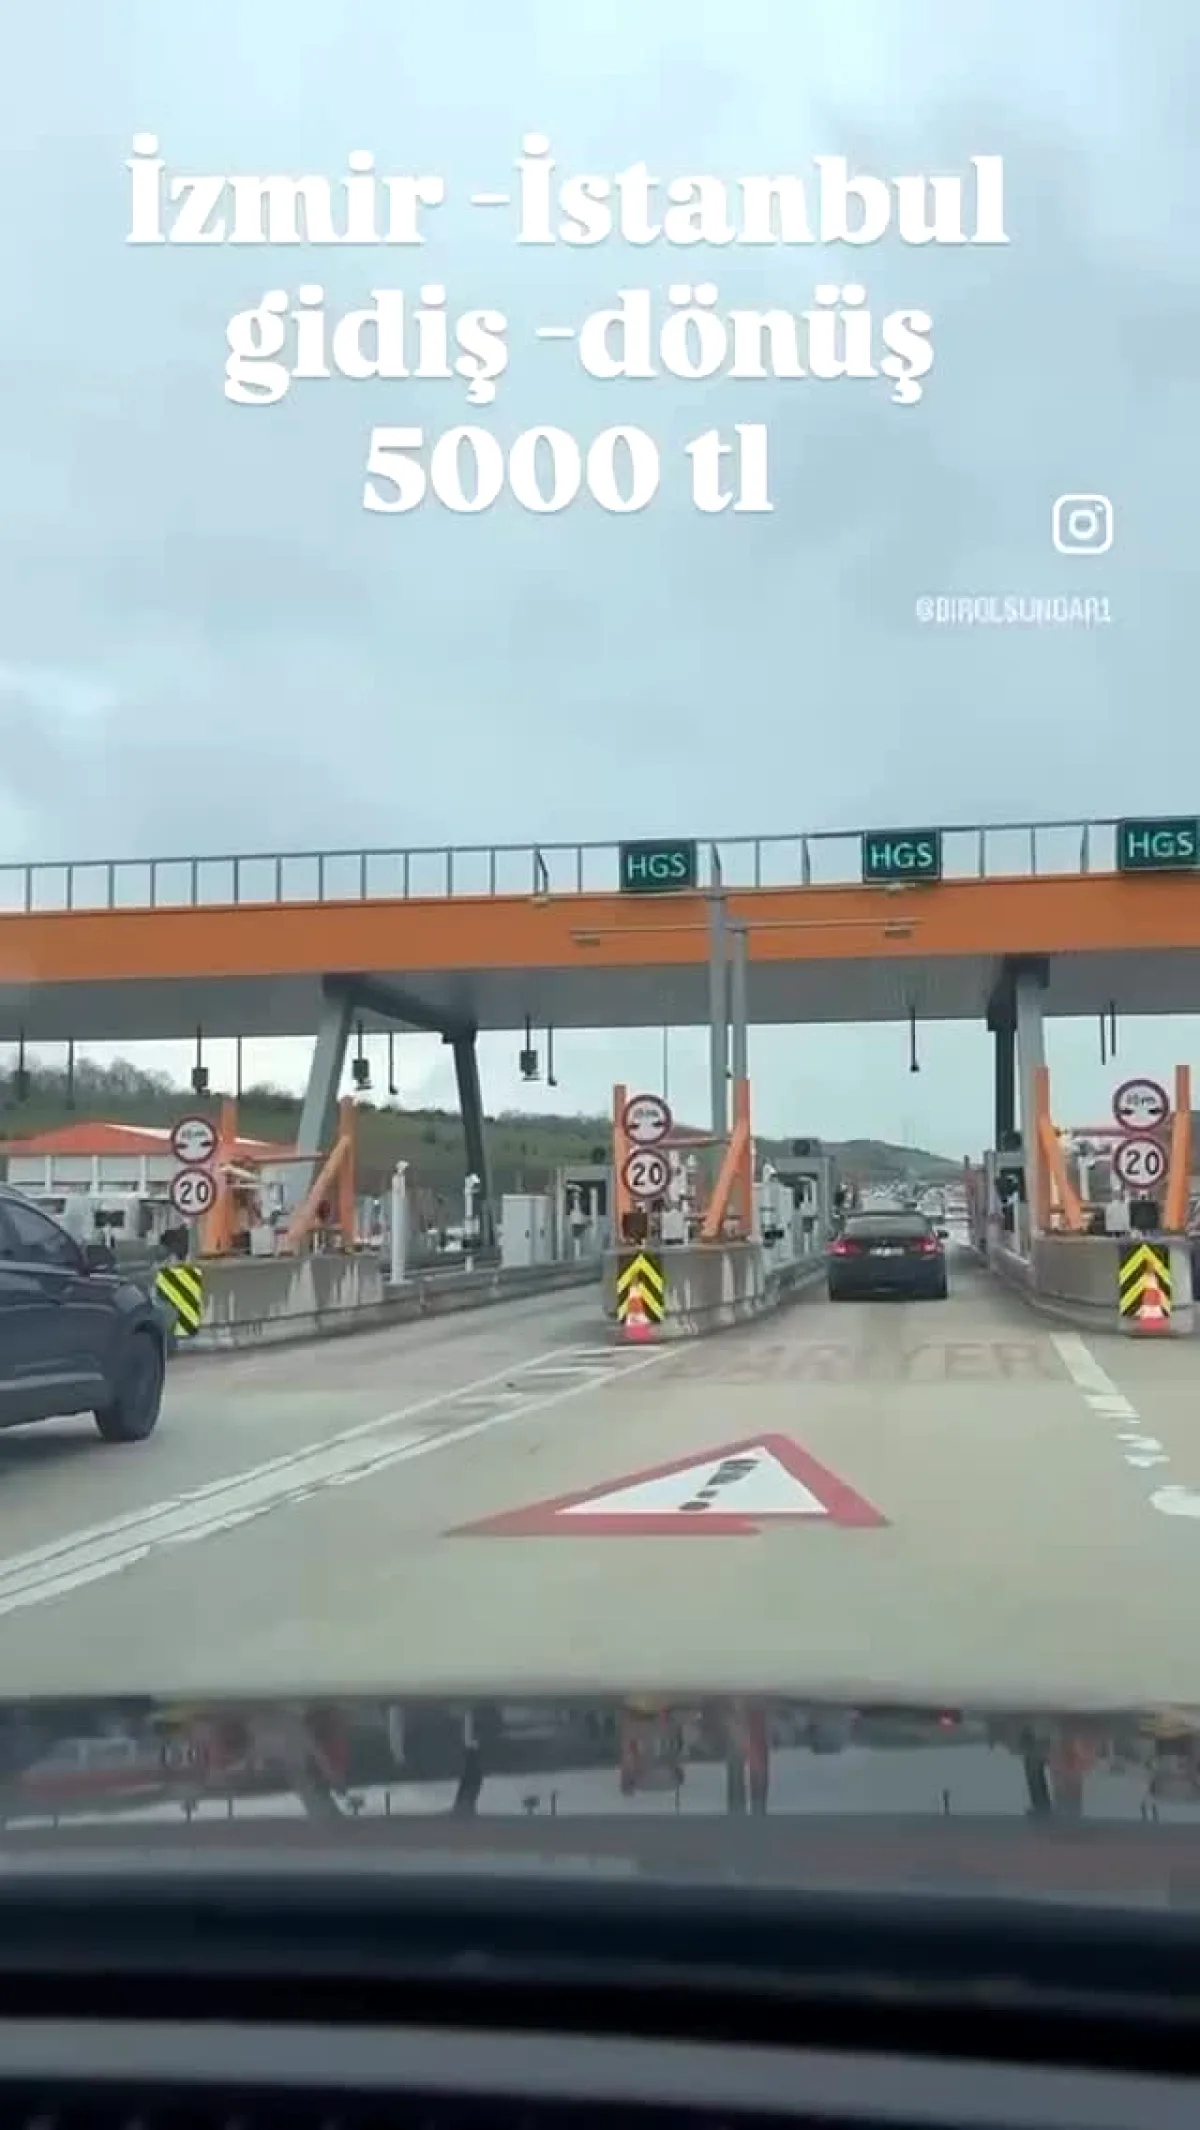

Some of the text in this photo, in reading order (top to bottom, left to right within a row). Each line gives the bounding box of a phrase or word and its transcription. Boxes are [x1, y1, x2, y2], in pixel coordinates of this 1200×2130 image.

[871, 842, 934, 869] HGS
[1128, 831, 1195, 858] HGS
[627, 852, 687, 880] HGS
[632, 1162, 662, 1186] 20
[1126, 1149, 1160, 1175] 20
[180, 1180, 209, 1205] 20
